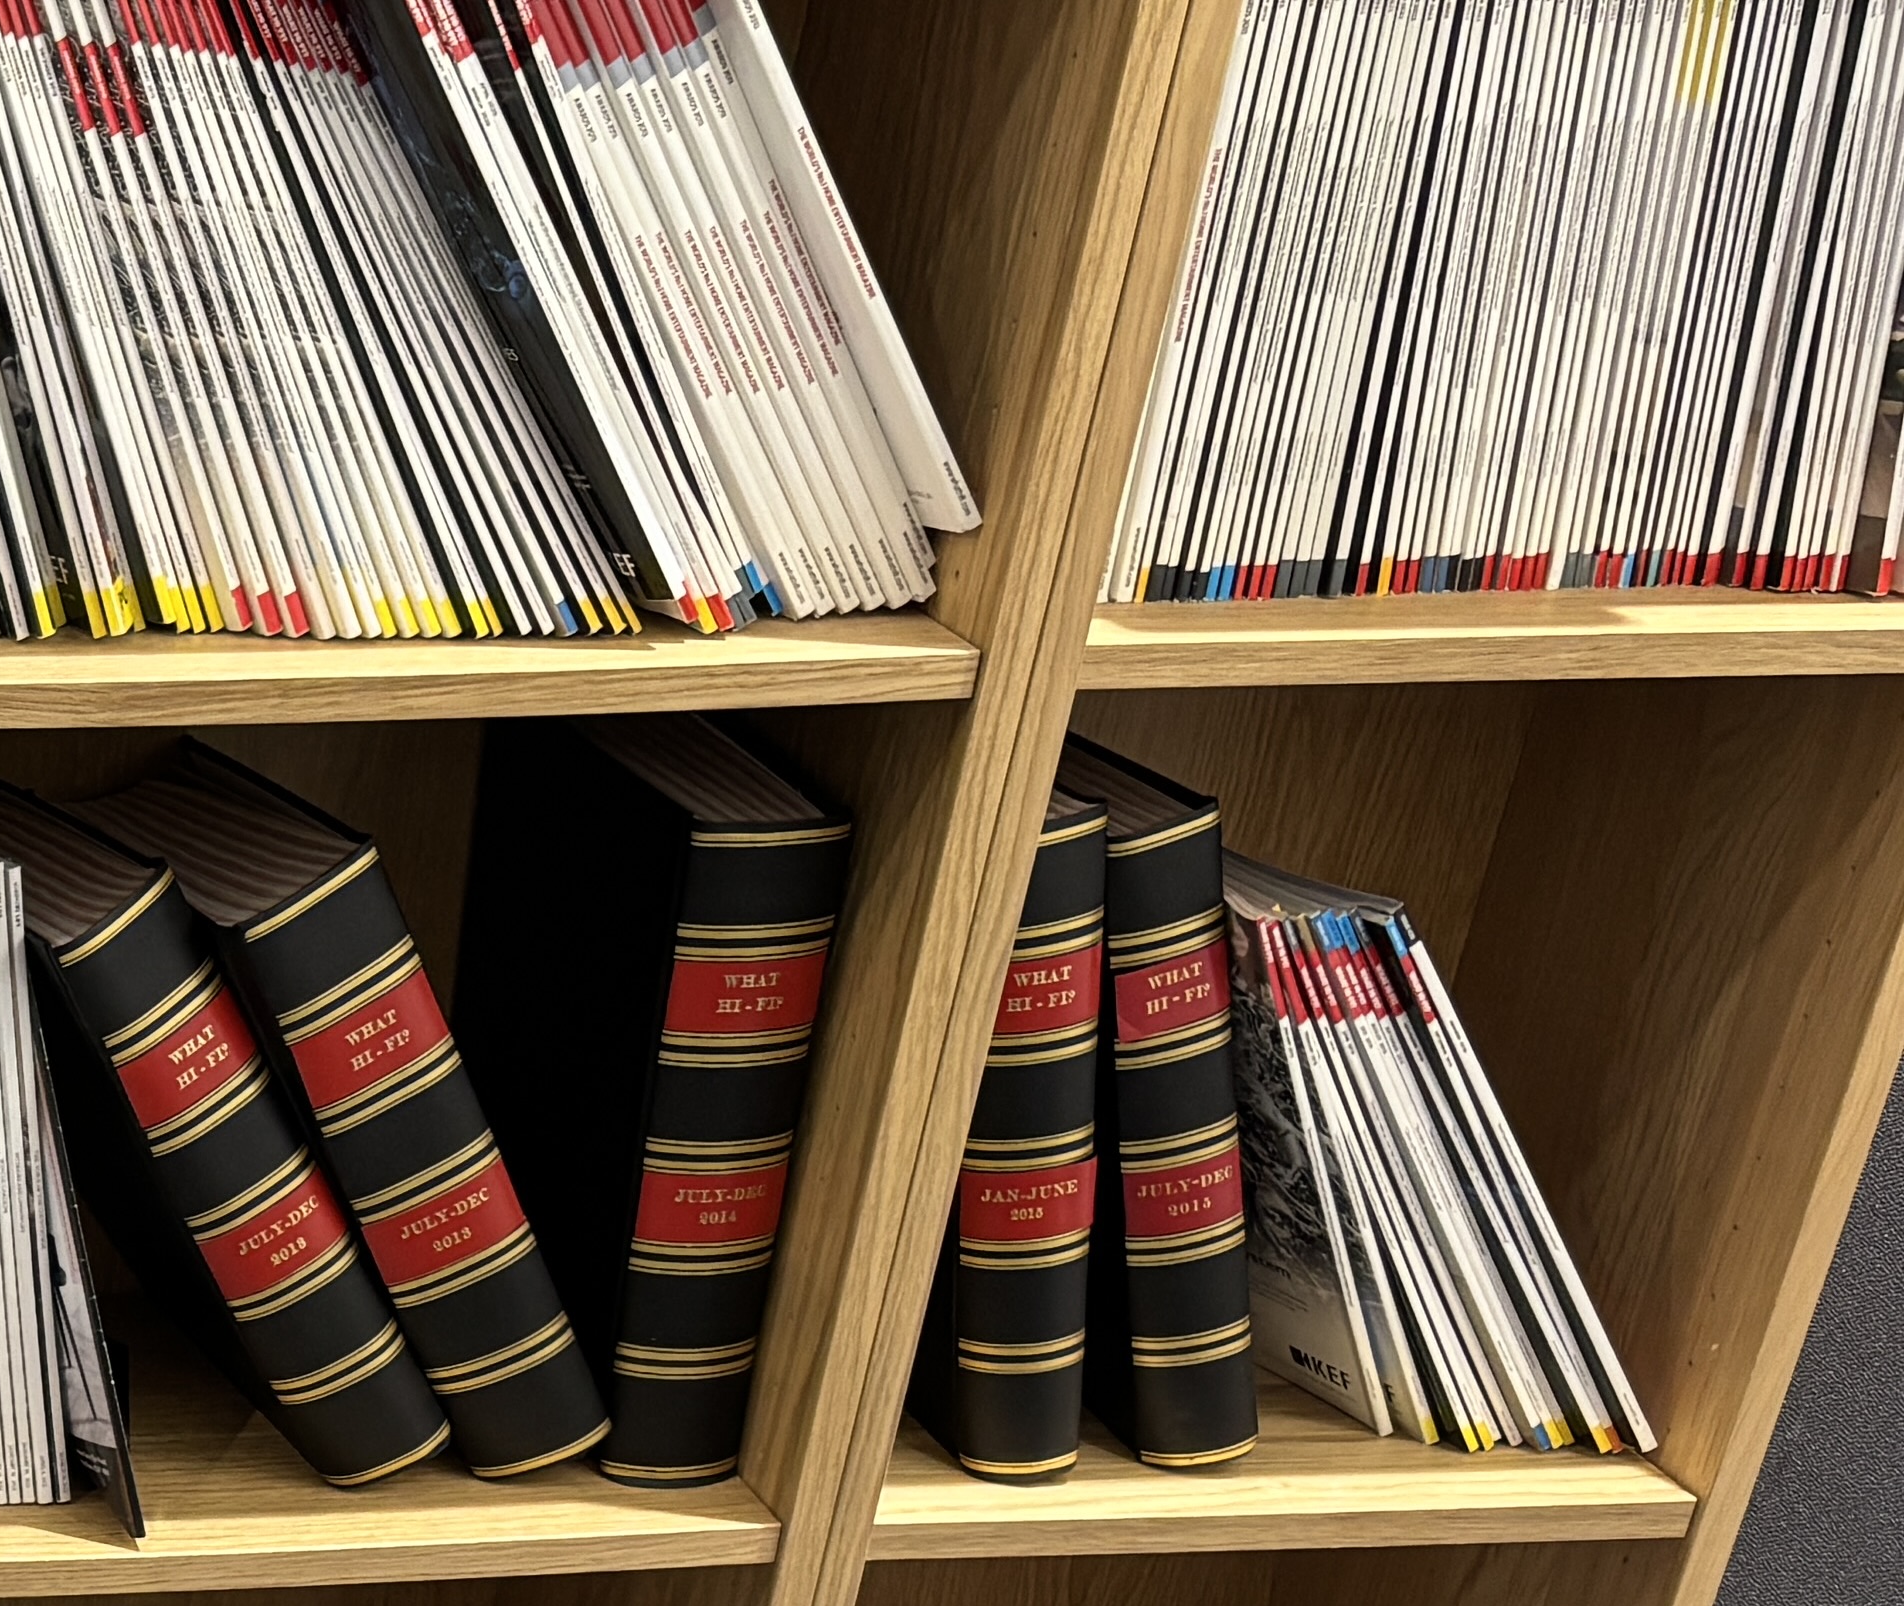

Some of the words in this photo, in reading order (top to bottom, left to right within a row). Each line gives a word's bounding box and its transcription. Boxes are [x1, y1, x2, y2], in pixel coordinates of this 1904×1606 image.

[723, 972, 781, 989] WHAT
[1013, 965, 1072, 988] WHAT
[1147, 961, 1203, 990] WHAT
[345, 1009, 398, 1047] WHAT
[168, 1024, 215, 1066] WHAT
[675, 1184, 767, 1204] JULY-DEC
[980, 1179, 1079, 1203] JAN-JUNE
[1137, 1165, 1234, 1198] JULY-DEC
[400, 1187, 491, 1240] JULY-DEC
[698, 1210, 737, 1226] 2014
[1010, 1207, 1044, 1221] 2015
[1167, 1197, 1212, 1217] 2015
[238, 1195, 320, 1256] JULY-DEC
[432, 1226, 473, 1253] 2013
[270, 1236, 308, 1267] 2013
[1312, 1356, 1351, 1390] KEF
